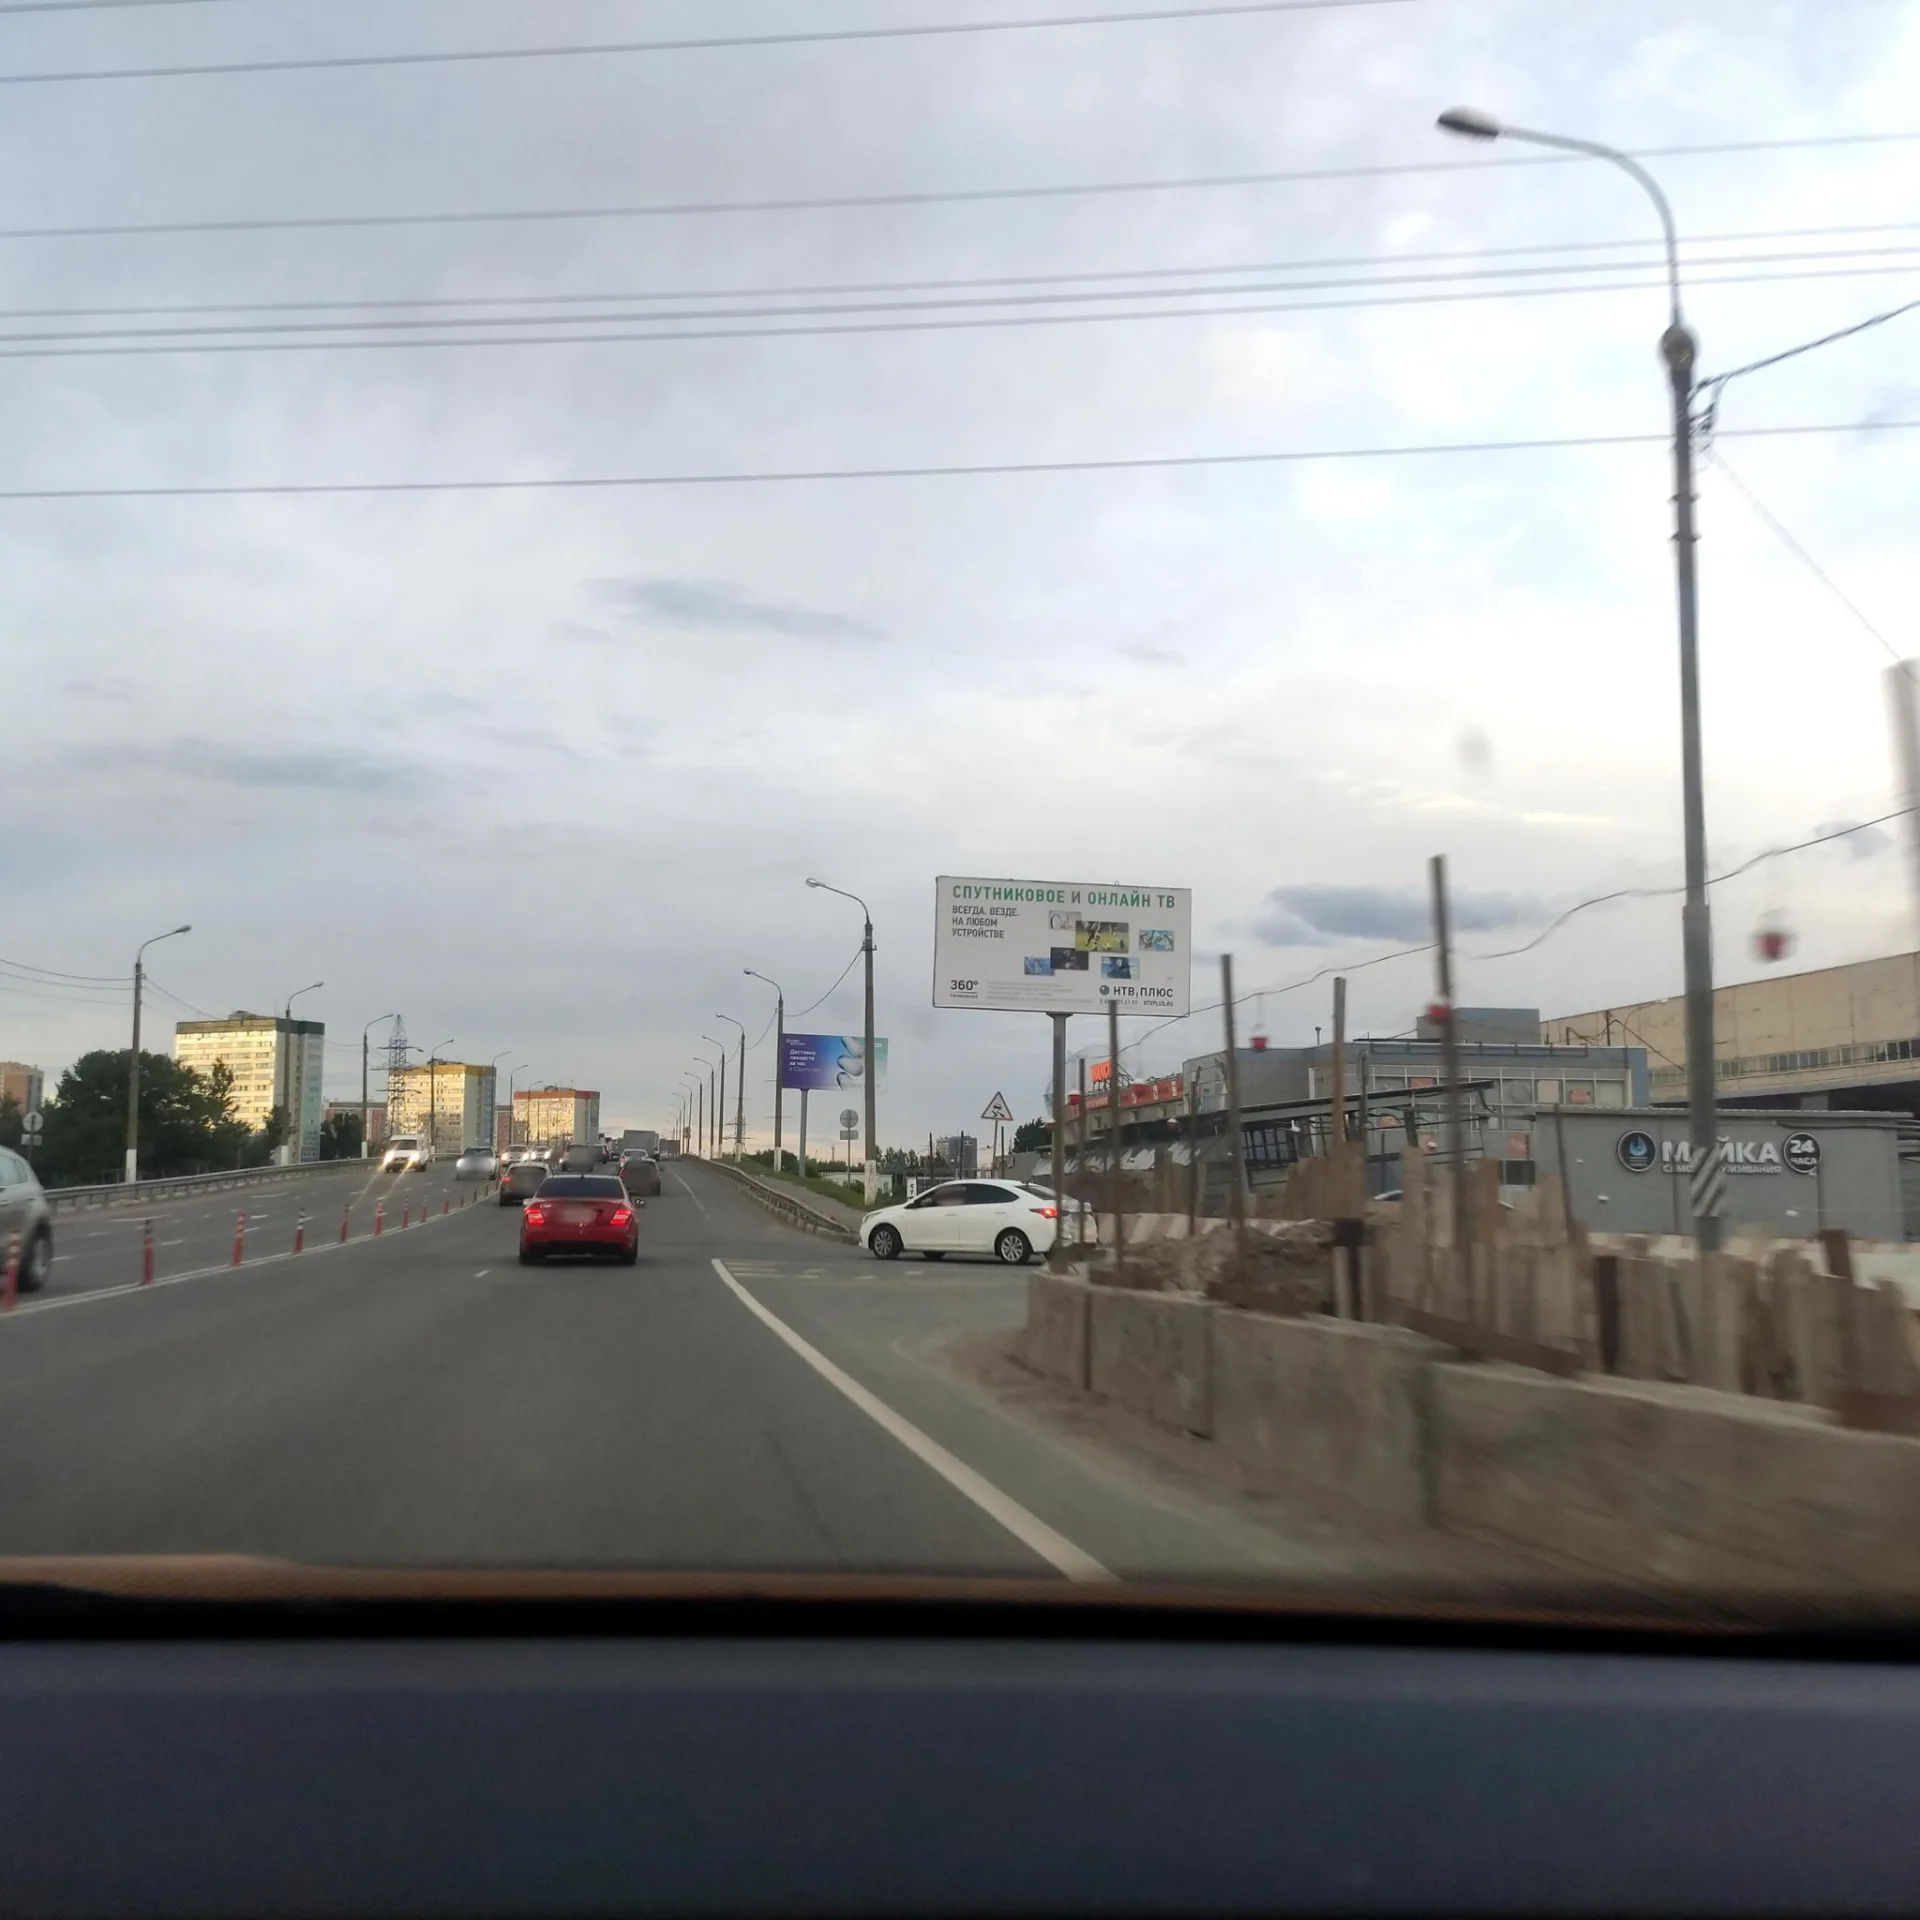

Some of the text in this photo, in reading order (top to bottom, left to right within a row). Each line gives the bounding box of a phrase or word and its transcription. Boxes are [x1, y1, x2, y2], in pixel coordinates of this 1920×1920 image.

[952, 884, 1176, 909] СПУТНИКОВОЕ И ОНЛАЙН ТВ
[951, 917, 998, 927] НА ЛЮБОМ
[951, 927, 1005, 939] УСТРОЙСТВЕ
[1661, 1136, 1780, 1164] МЙКА
[1790, 1139, 1816, 1154] 24
